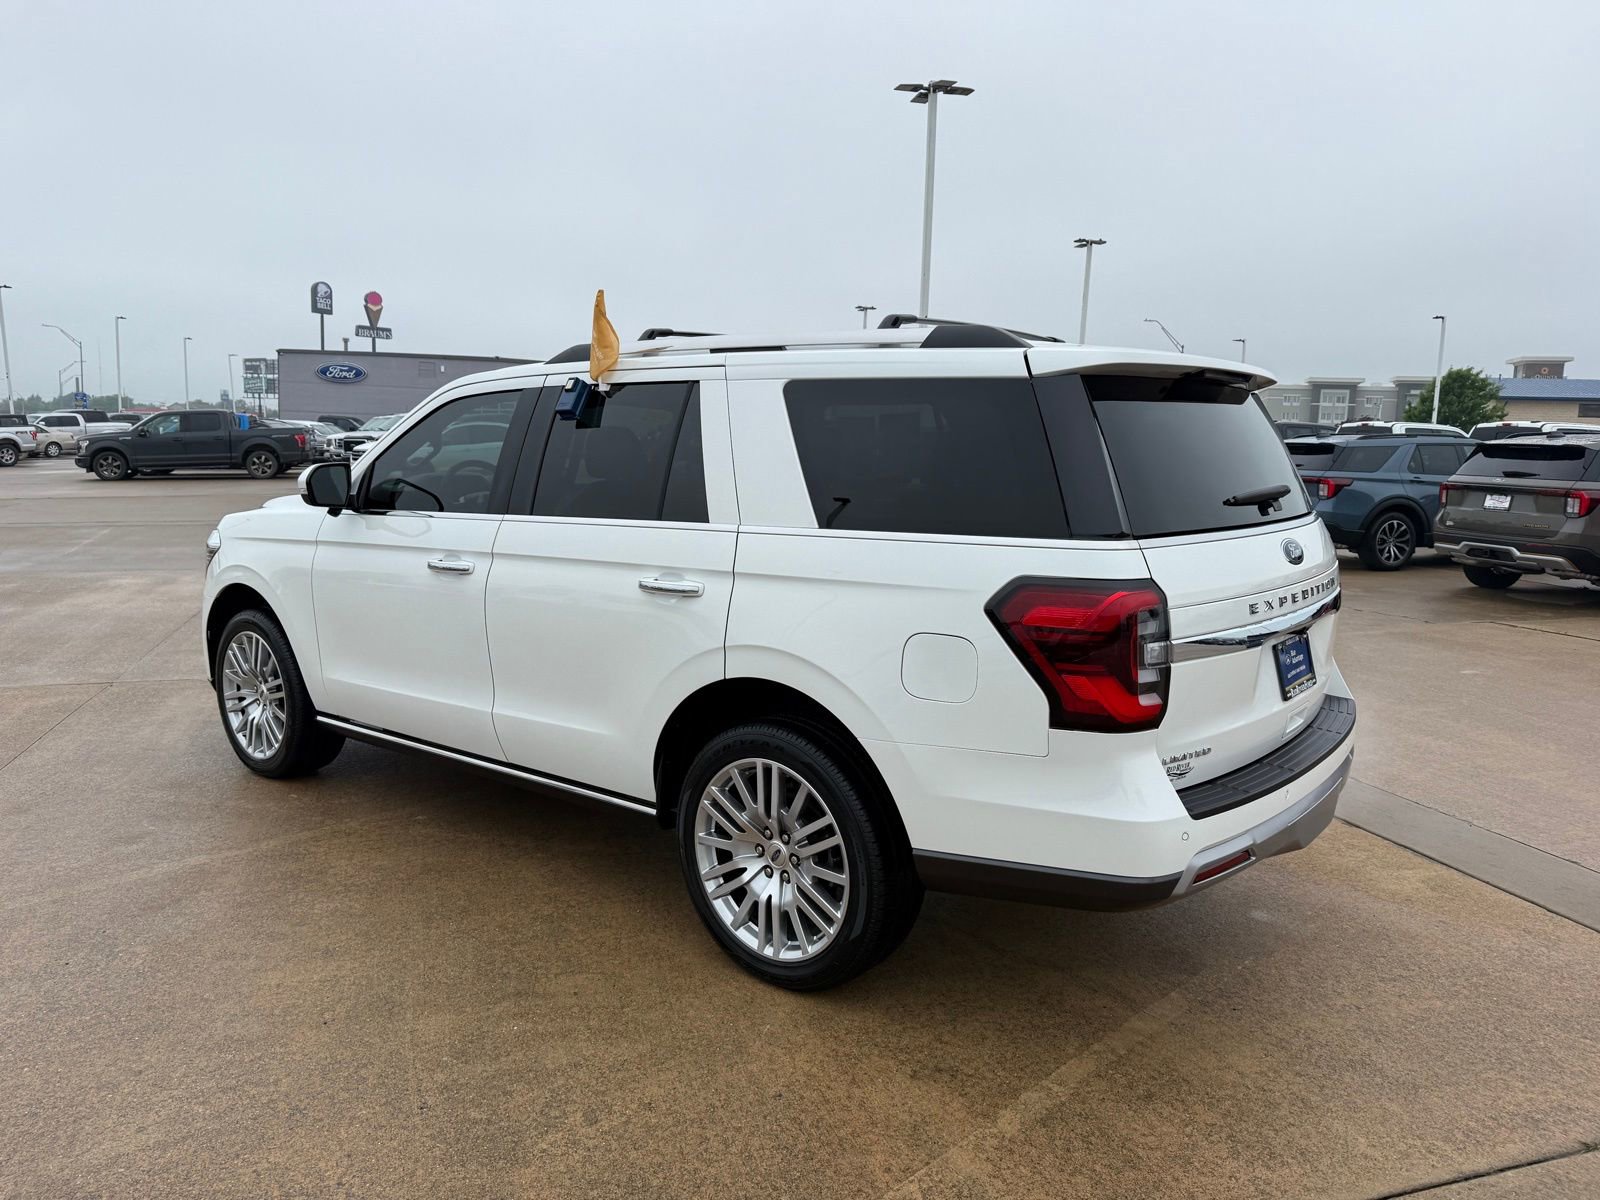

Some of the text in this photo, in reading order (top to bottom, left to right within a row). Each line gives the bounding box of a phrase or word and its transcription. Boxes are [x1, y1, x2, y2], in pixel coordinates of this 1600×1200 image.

[358, 328, 392, 339] BRAUM'S
[326, 365, 356, 378] Ford
[1248, 577, 1336, 616] EXPEDITION
